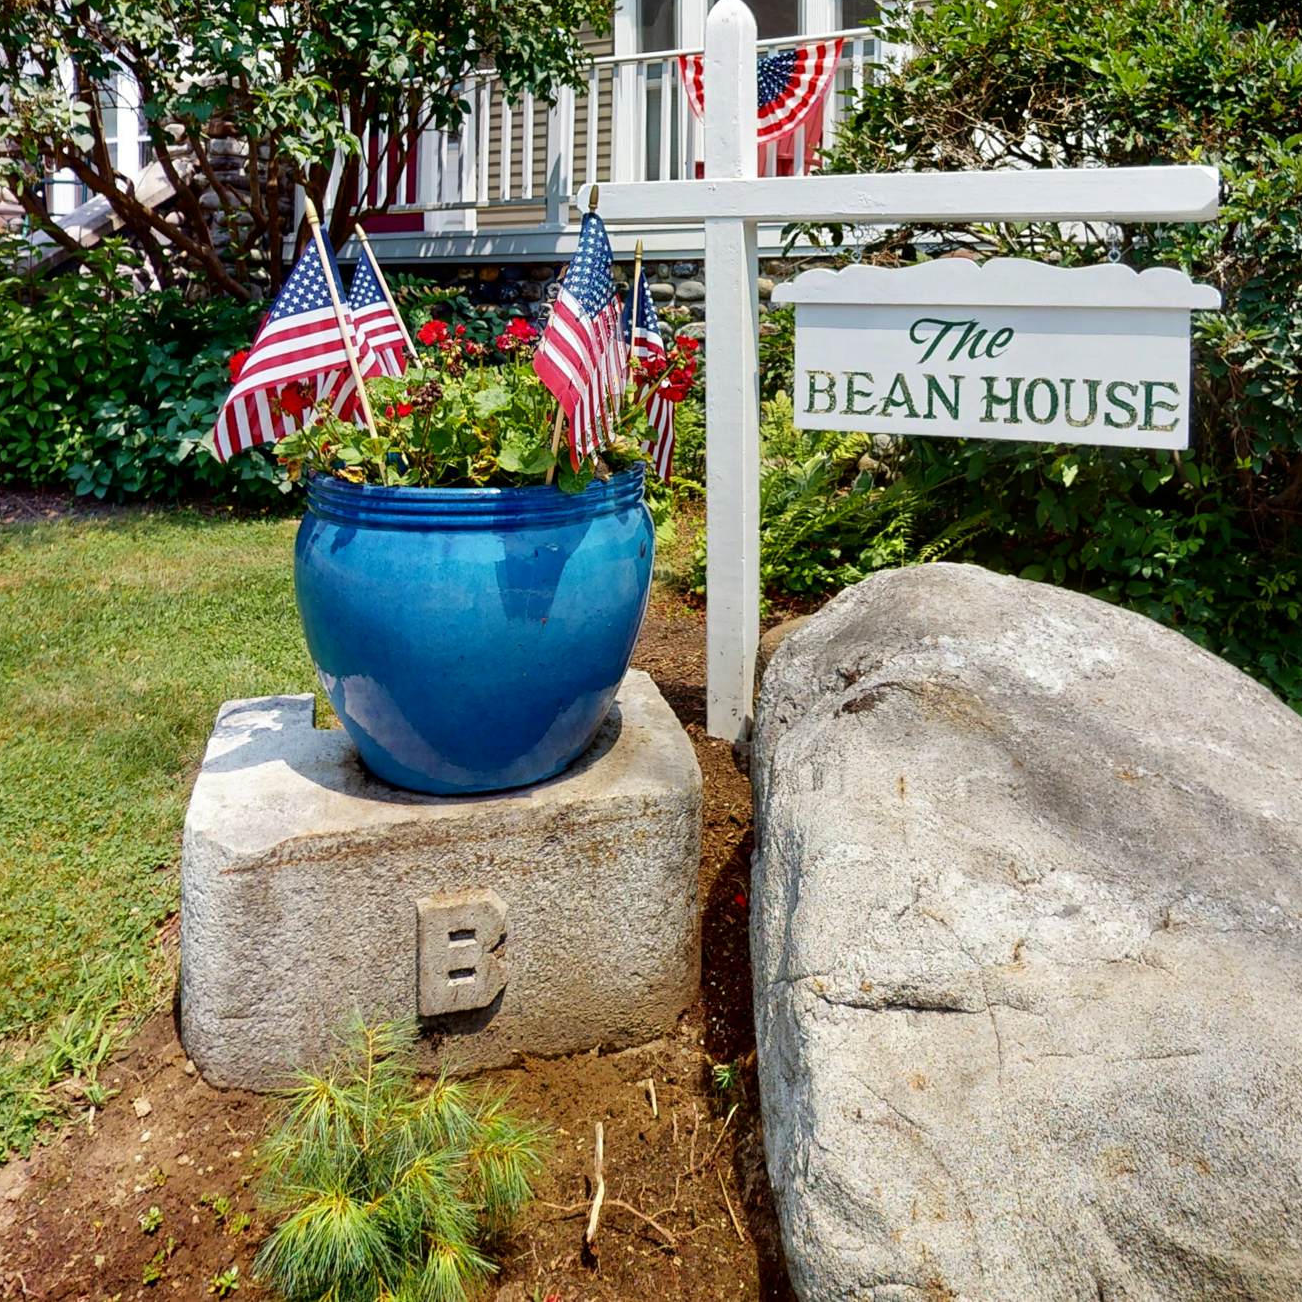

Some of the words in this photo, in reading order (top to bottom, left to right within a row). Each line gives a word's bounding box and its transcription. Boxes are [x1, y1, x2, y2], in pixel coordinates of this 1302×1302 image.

[909, 317, 1015, 364] The
[803, 369, 966, 421] BEAN
[979, 376, 1181, 433] HOUSE
[416, 888, 509, 1017] B
